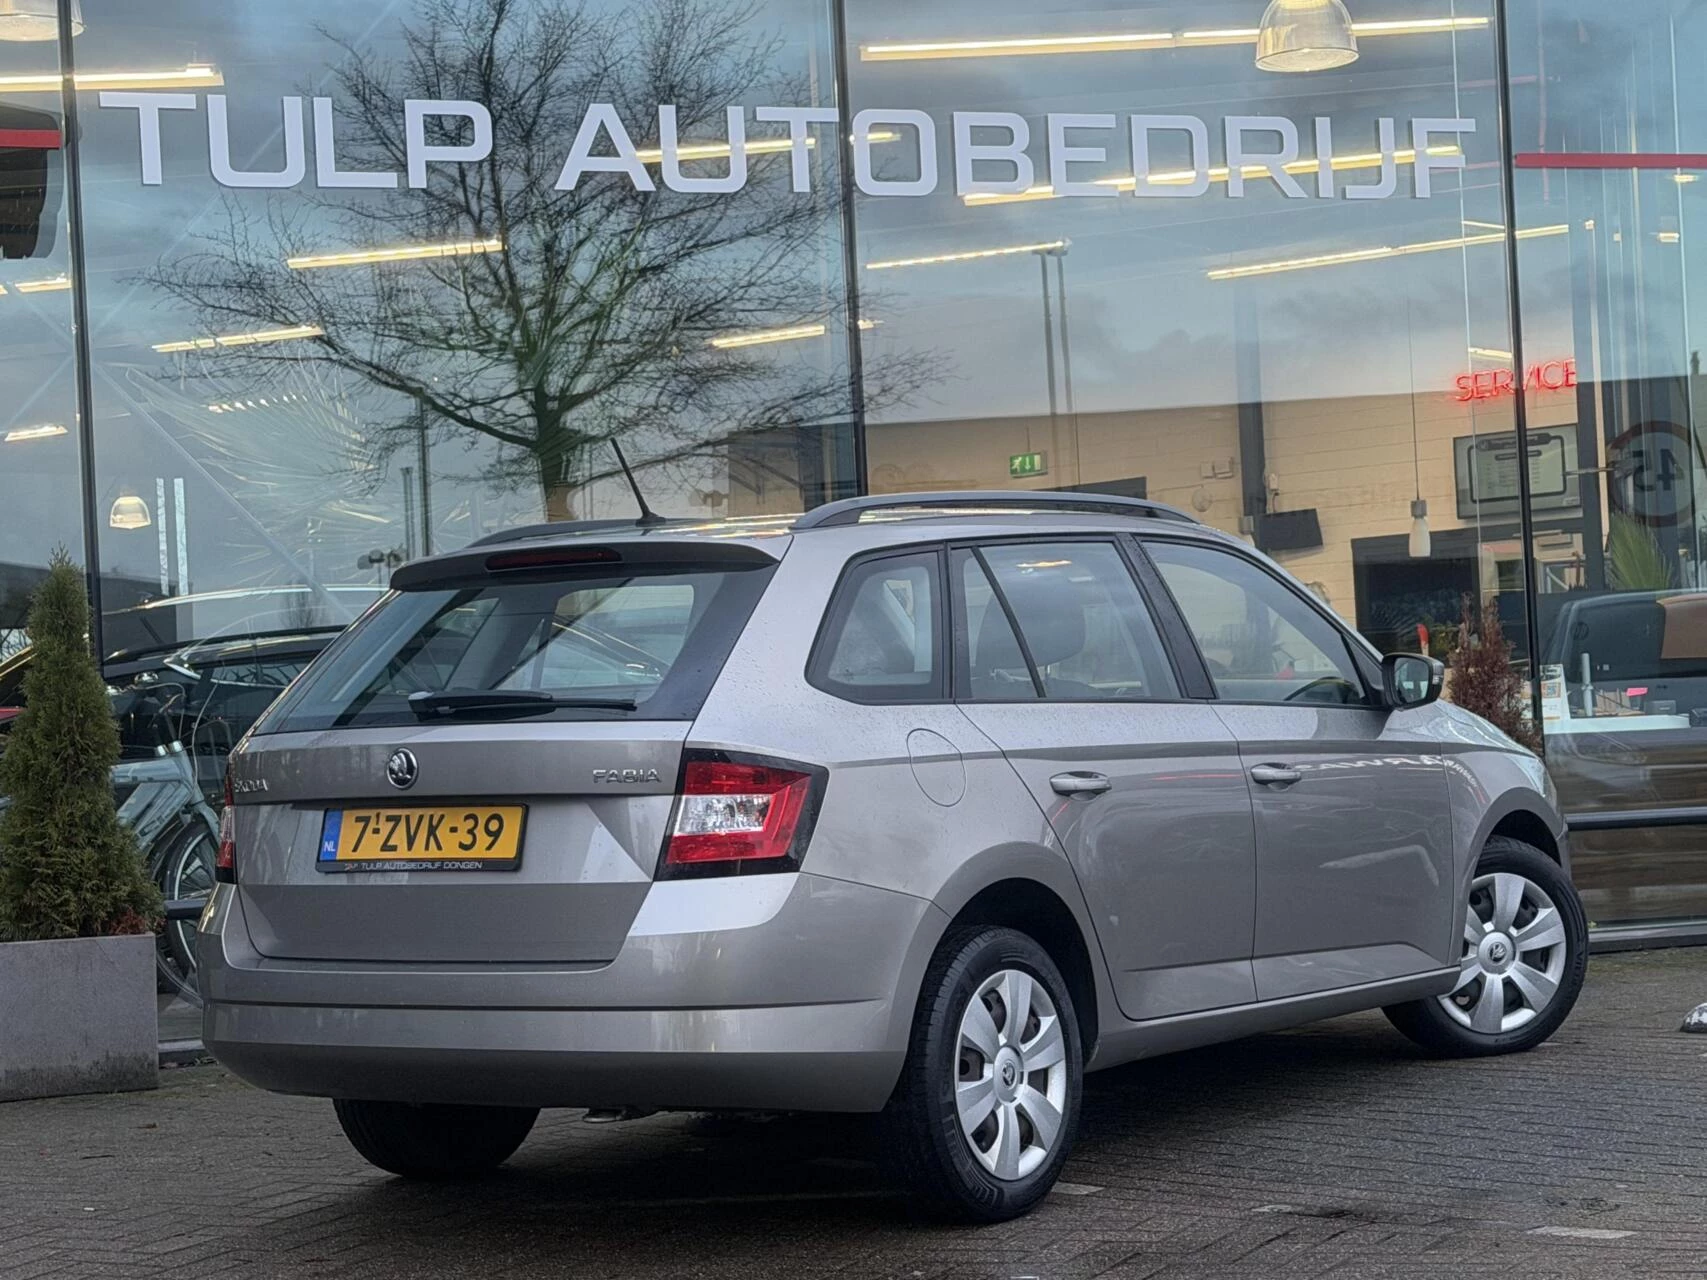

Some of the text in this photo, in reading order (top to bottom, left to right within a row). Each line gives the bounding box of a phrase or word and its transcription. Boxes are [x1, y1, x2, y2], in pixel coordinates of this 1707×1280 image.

[99, 91, 1476, 200] TULP AUTOBEDRIJF
[592, 768, 662, 784] FABIA
[323, 840, 337, 852] NL
[443, 860, 483, 870] DONGEN
